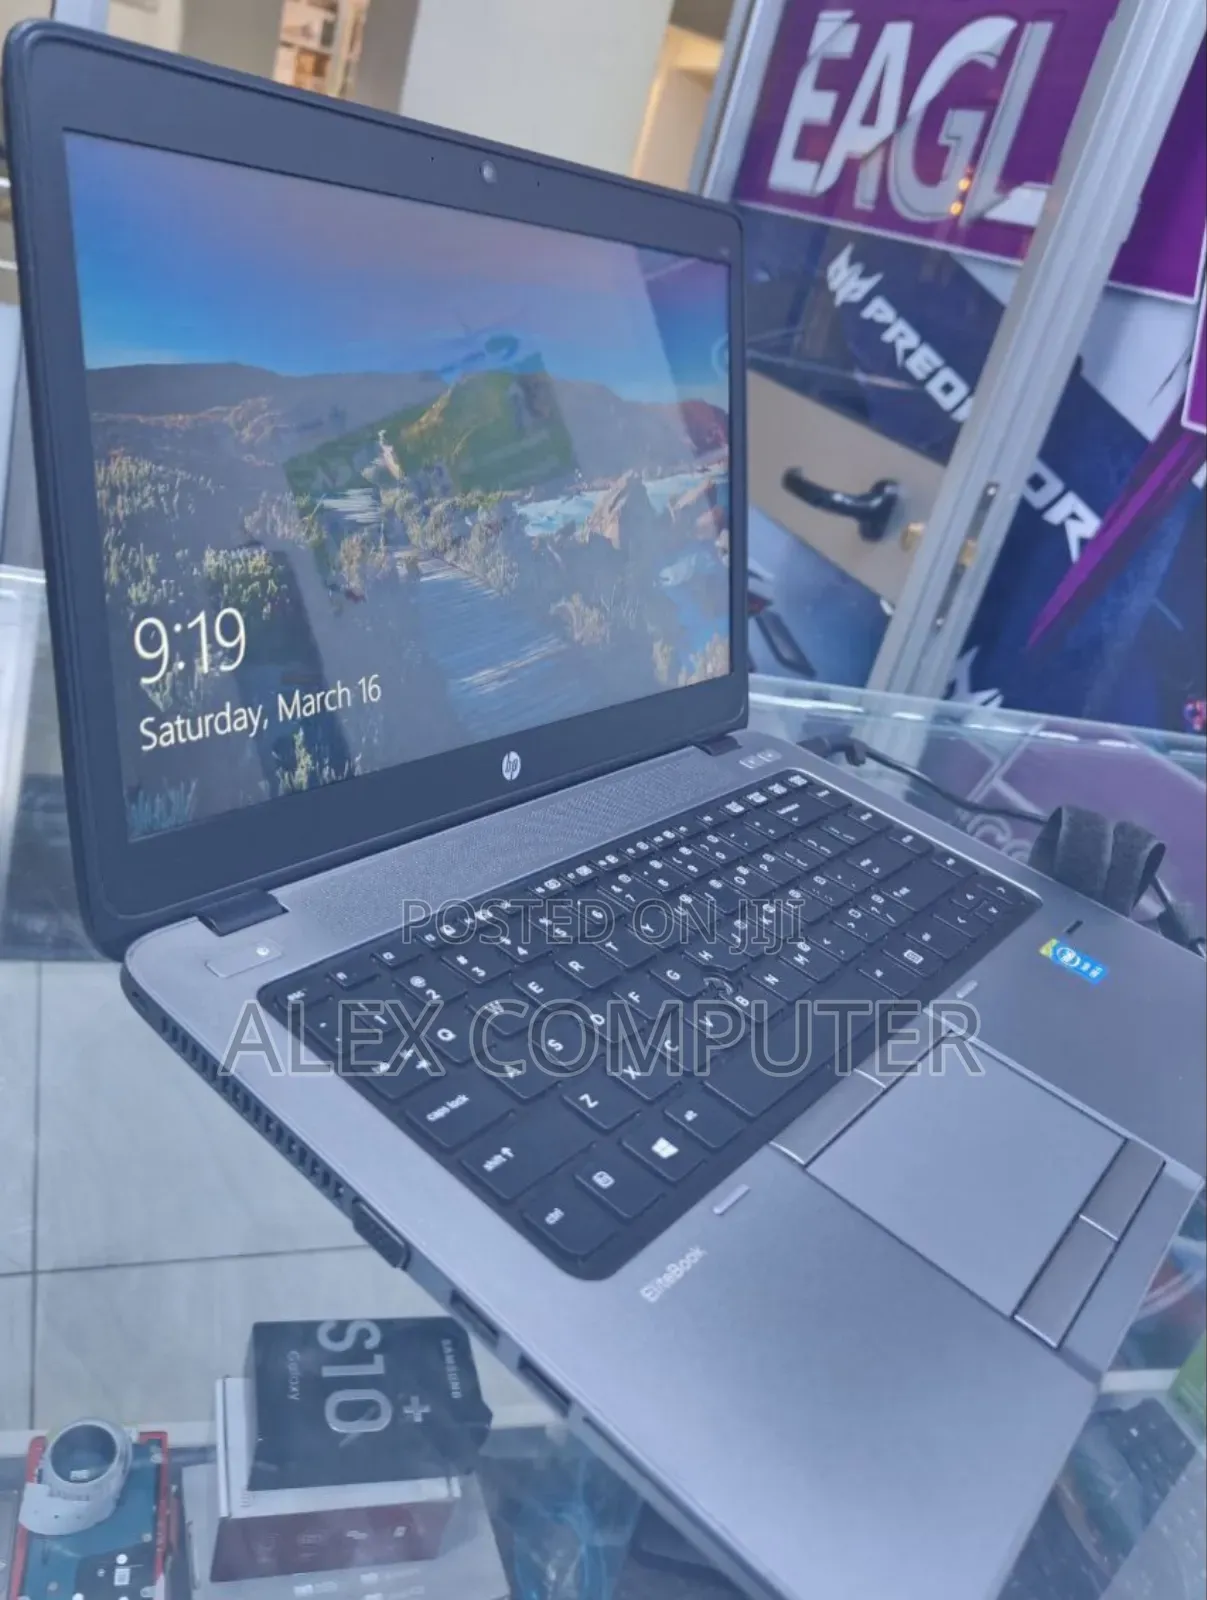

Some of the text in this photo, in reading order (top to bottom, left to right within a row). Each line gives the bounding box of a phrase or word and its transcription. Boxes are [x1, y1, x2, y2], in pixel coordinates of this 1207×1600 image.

[134, 607, 246, 684] 9:19
[139, 674, 382, 751] Saturday, March 16
[605, 941, 618, 952] T
[698, 950, 713, 961] H
[568, 960, 584, 972] R
[666, 969, 681, 981] G
[527, 981, 544, 994] E
[425, 989, 441, 1001] 2
[628, 991, 640, 1003] F
[437, 1028, 456, 1041] Q
[547, 1039, 564, 1052] S
[623, 1065, 642, 1080] X
[579, 1093, 599, 1108] Z
[640, 1245, 708, 1302] EliteBook
